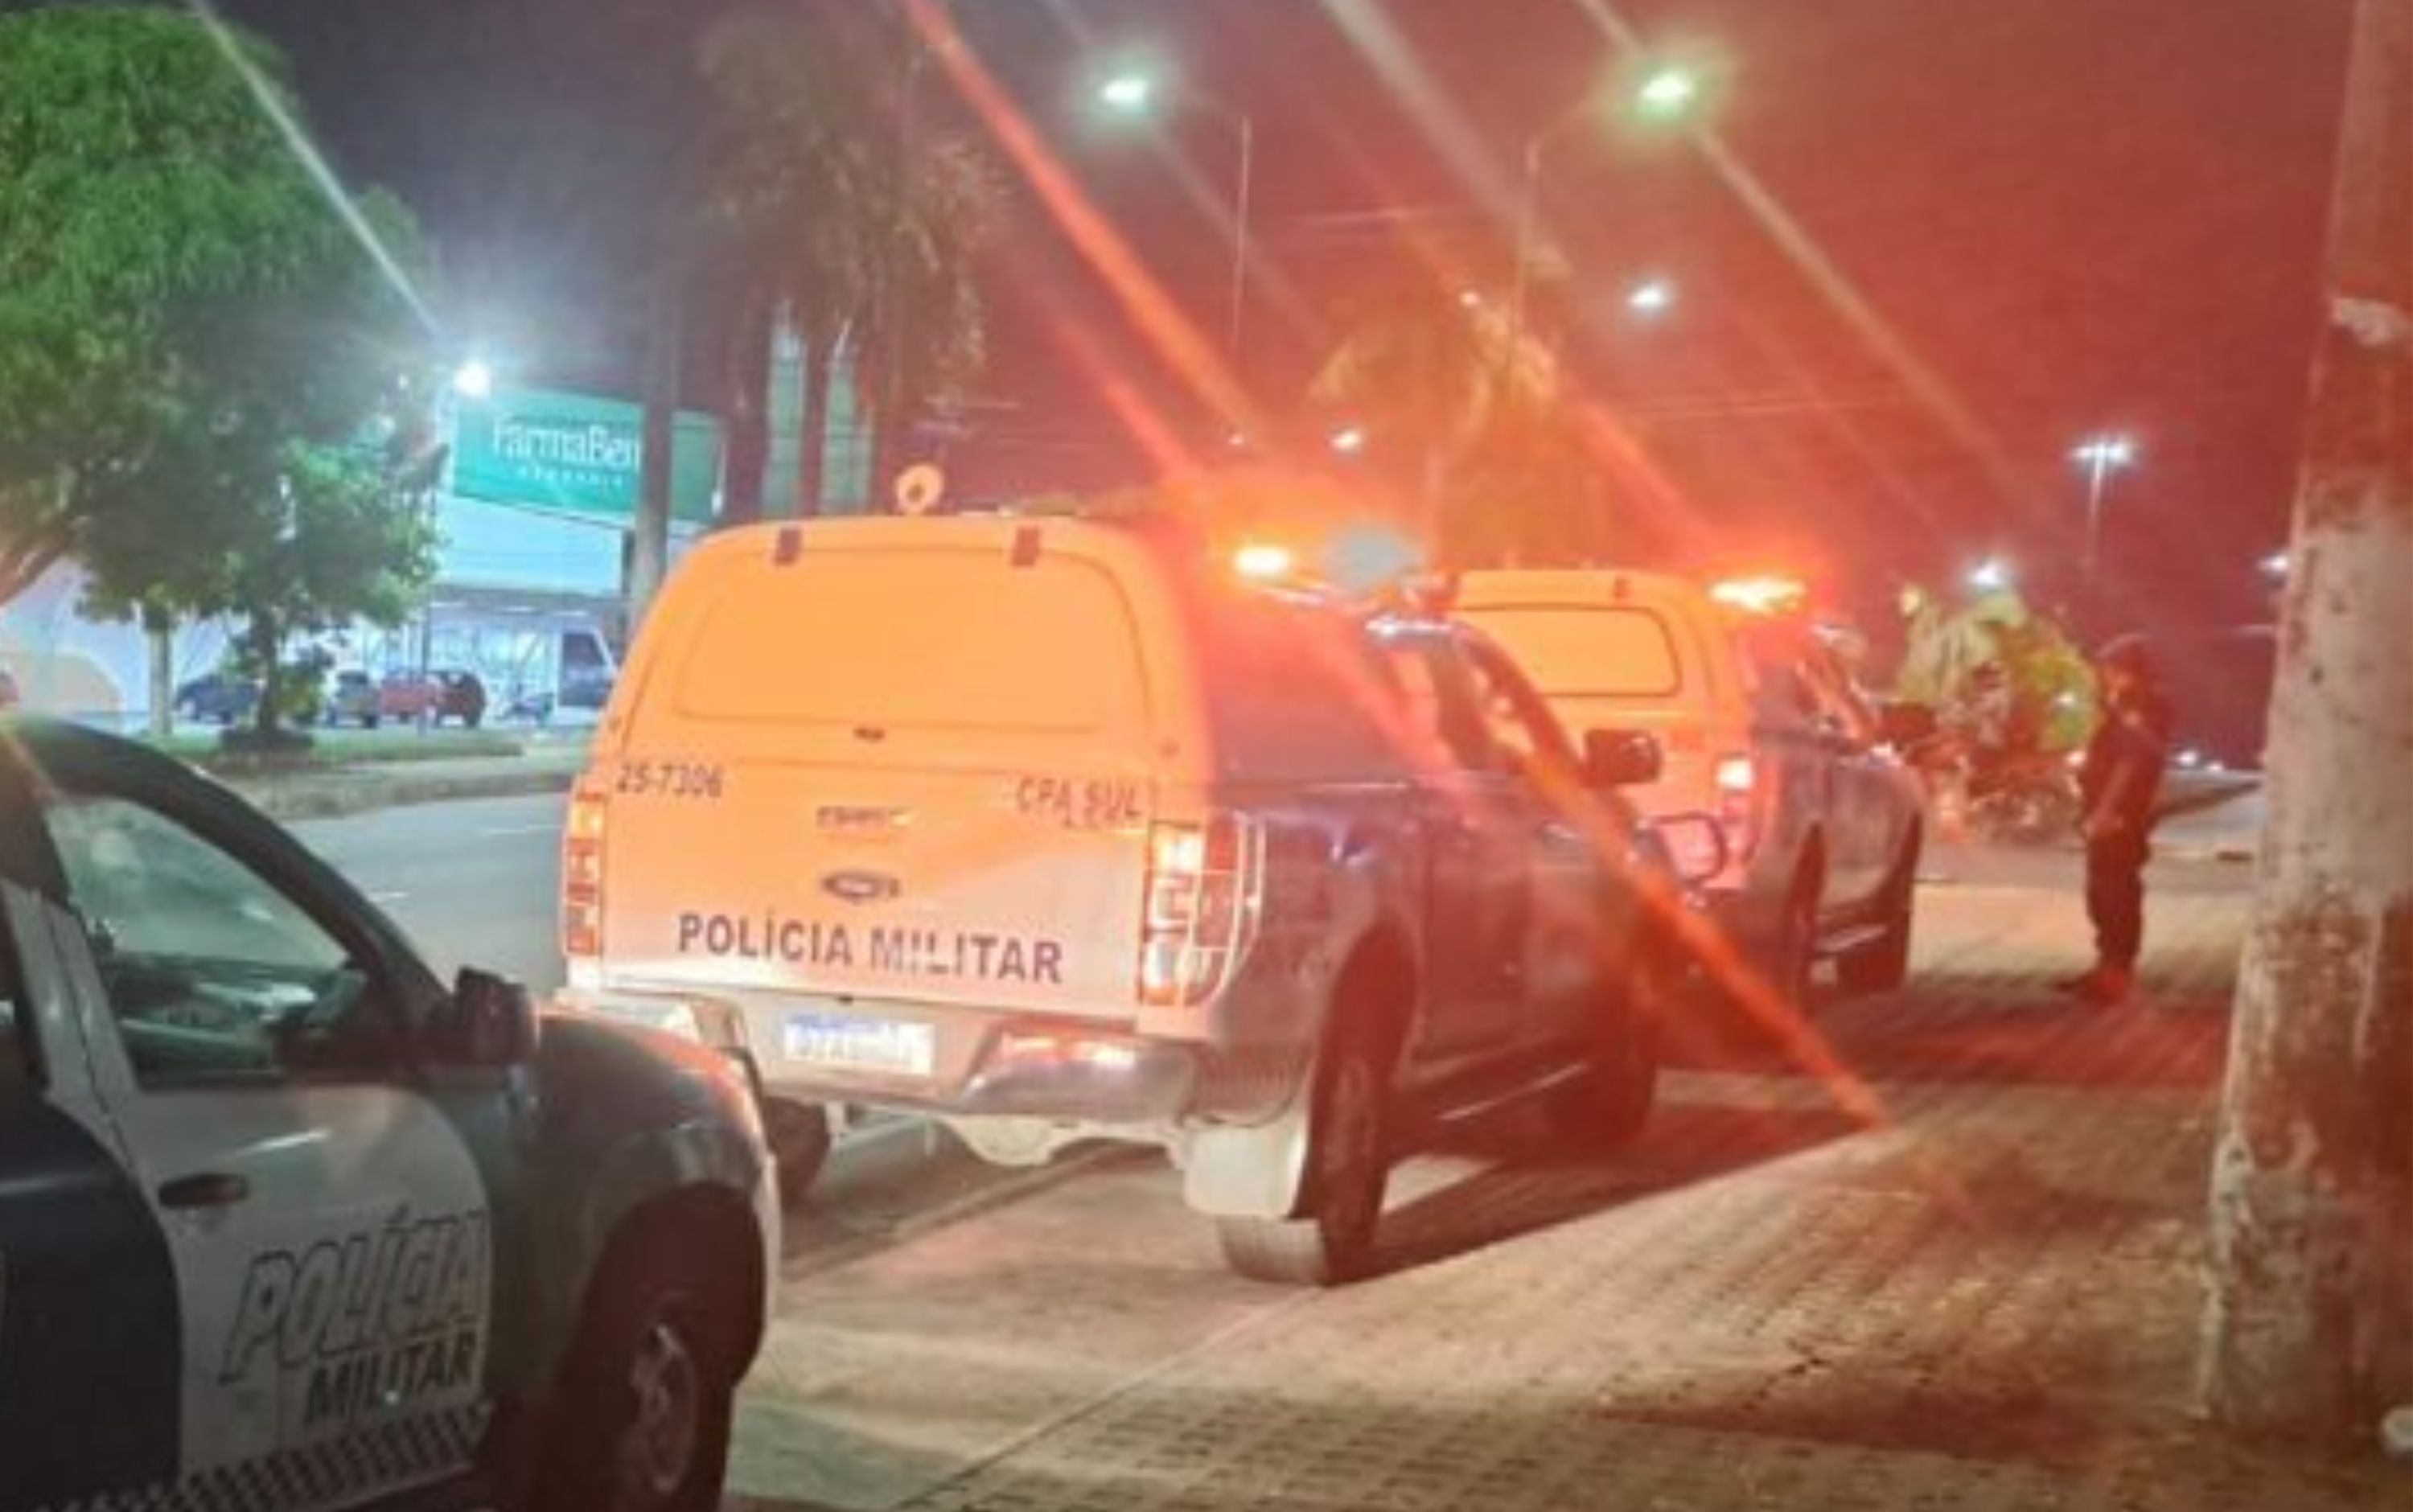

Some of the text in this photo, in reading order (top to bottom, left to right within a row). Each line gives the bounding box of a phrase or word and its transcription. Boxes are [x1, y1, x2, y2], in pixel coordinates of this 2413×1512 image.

[678, 909, 1063, 984] POLÍCIA MILITAR
[217, 1204, 486, 1386] POLÍCIA
[305, 1332, 478, 1424] MILITAR
